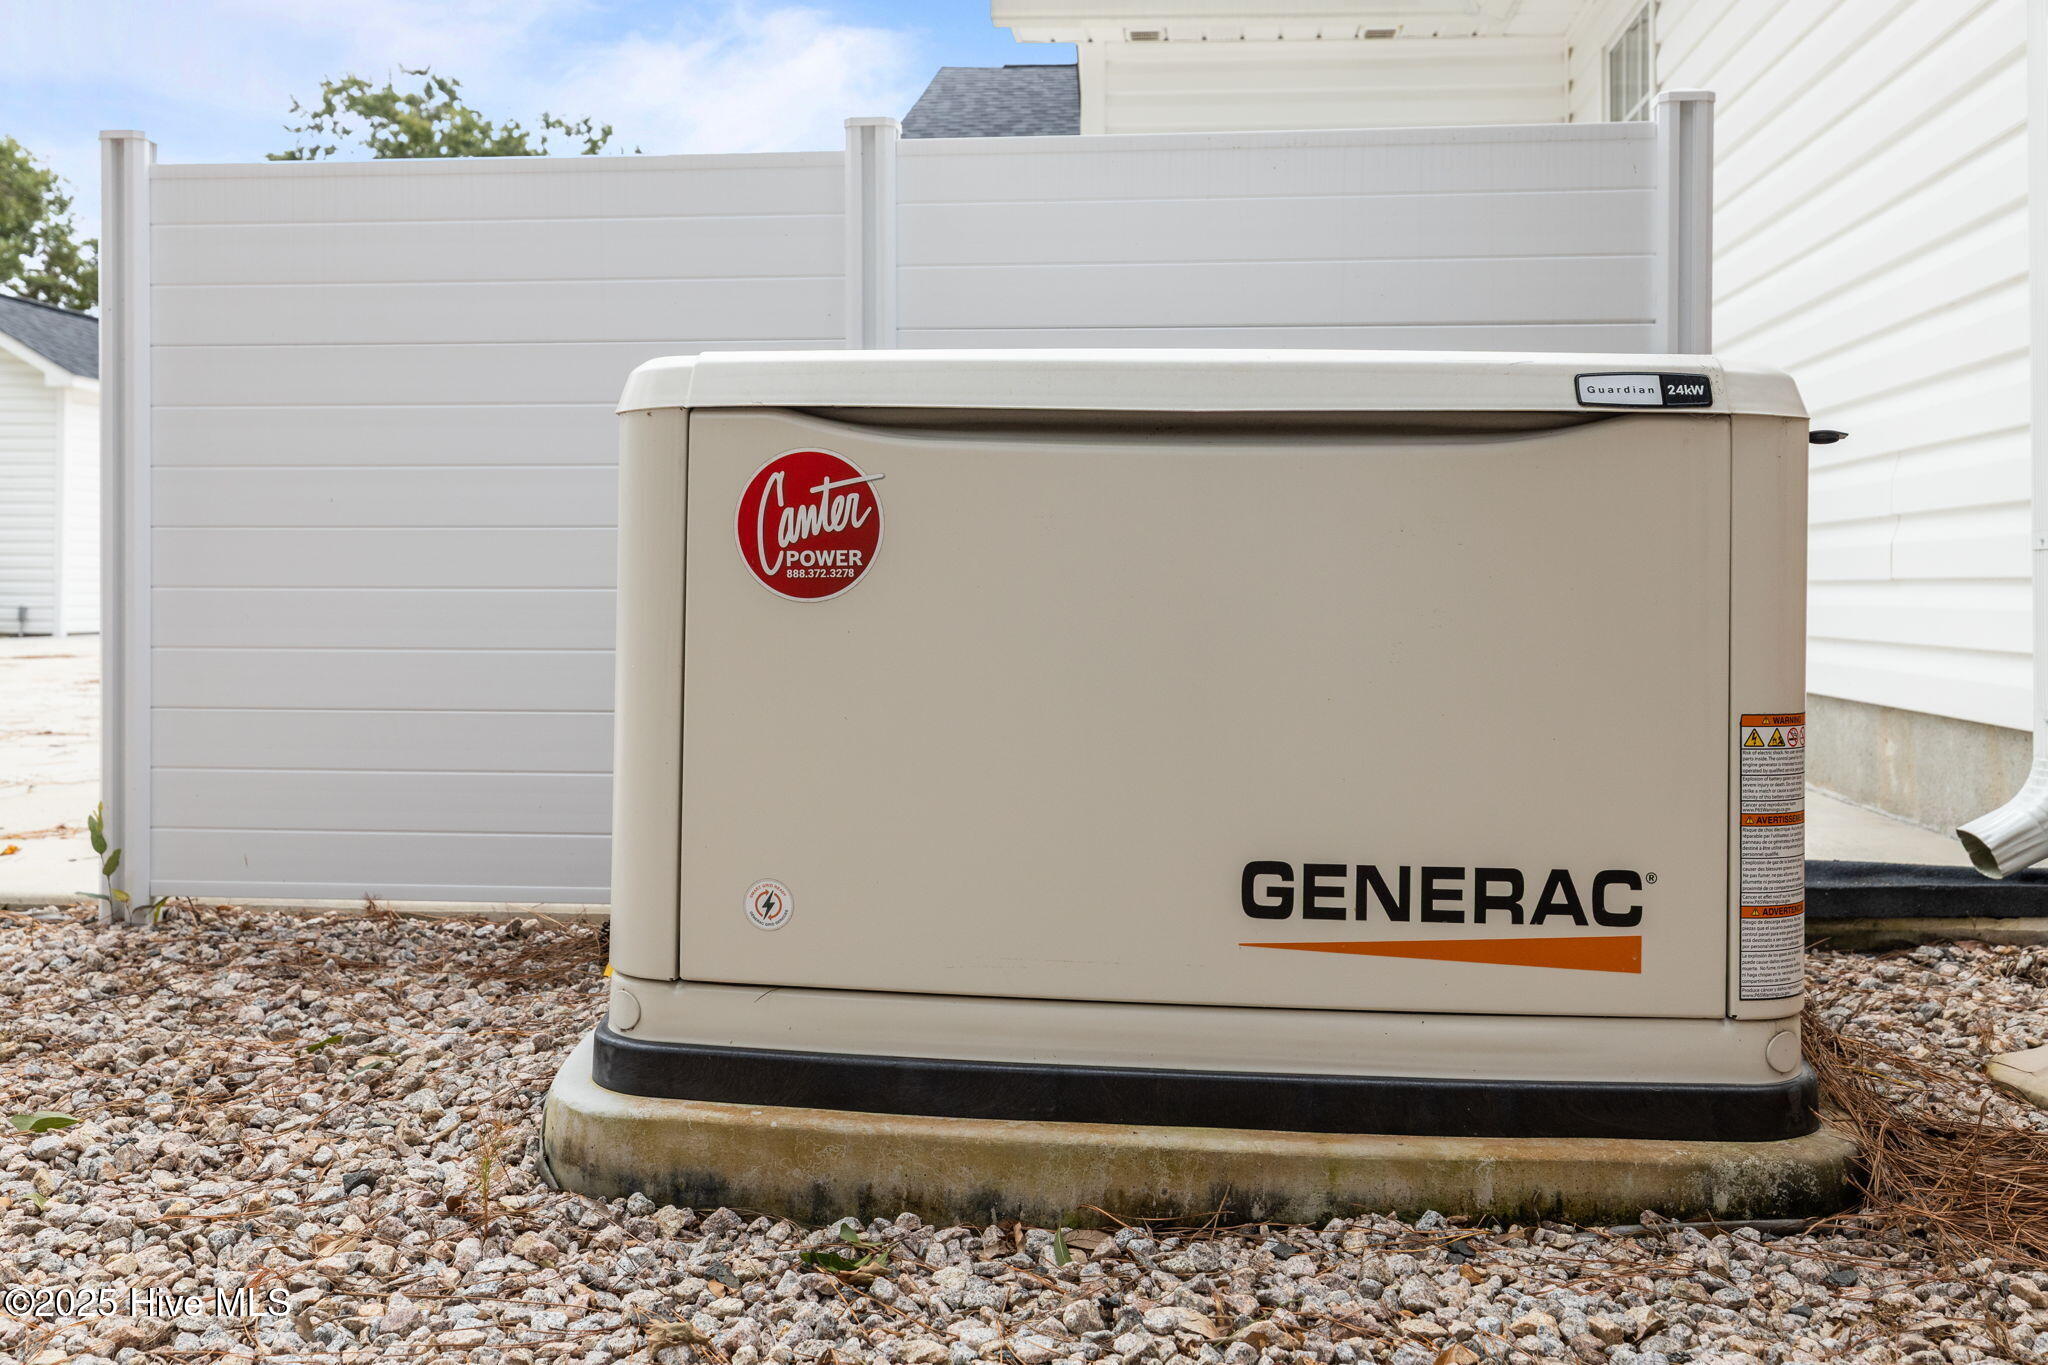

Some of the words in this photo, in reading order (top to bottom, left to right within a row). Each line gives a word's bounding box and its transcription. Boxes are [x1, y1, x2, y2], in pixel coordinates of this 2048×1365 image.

[1586, 385, 1655, 394] Guardian
[1667, 384, 1705, 396] 24kW
[757, 470, 885, 576] Canter
[786, 550, 863, 567] POWER
[786, 568, 855, 579] 888.372.3278
[1756, 815, 1804, 824] AVERTISSEME
